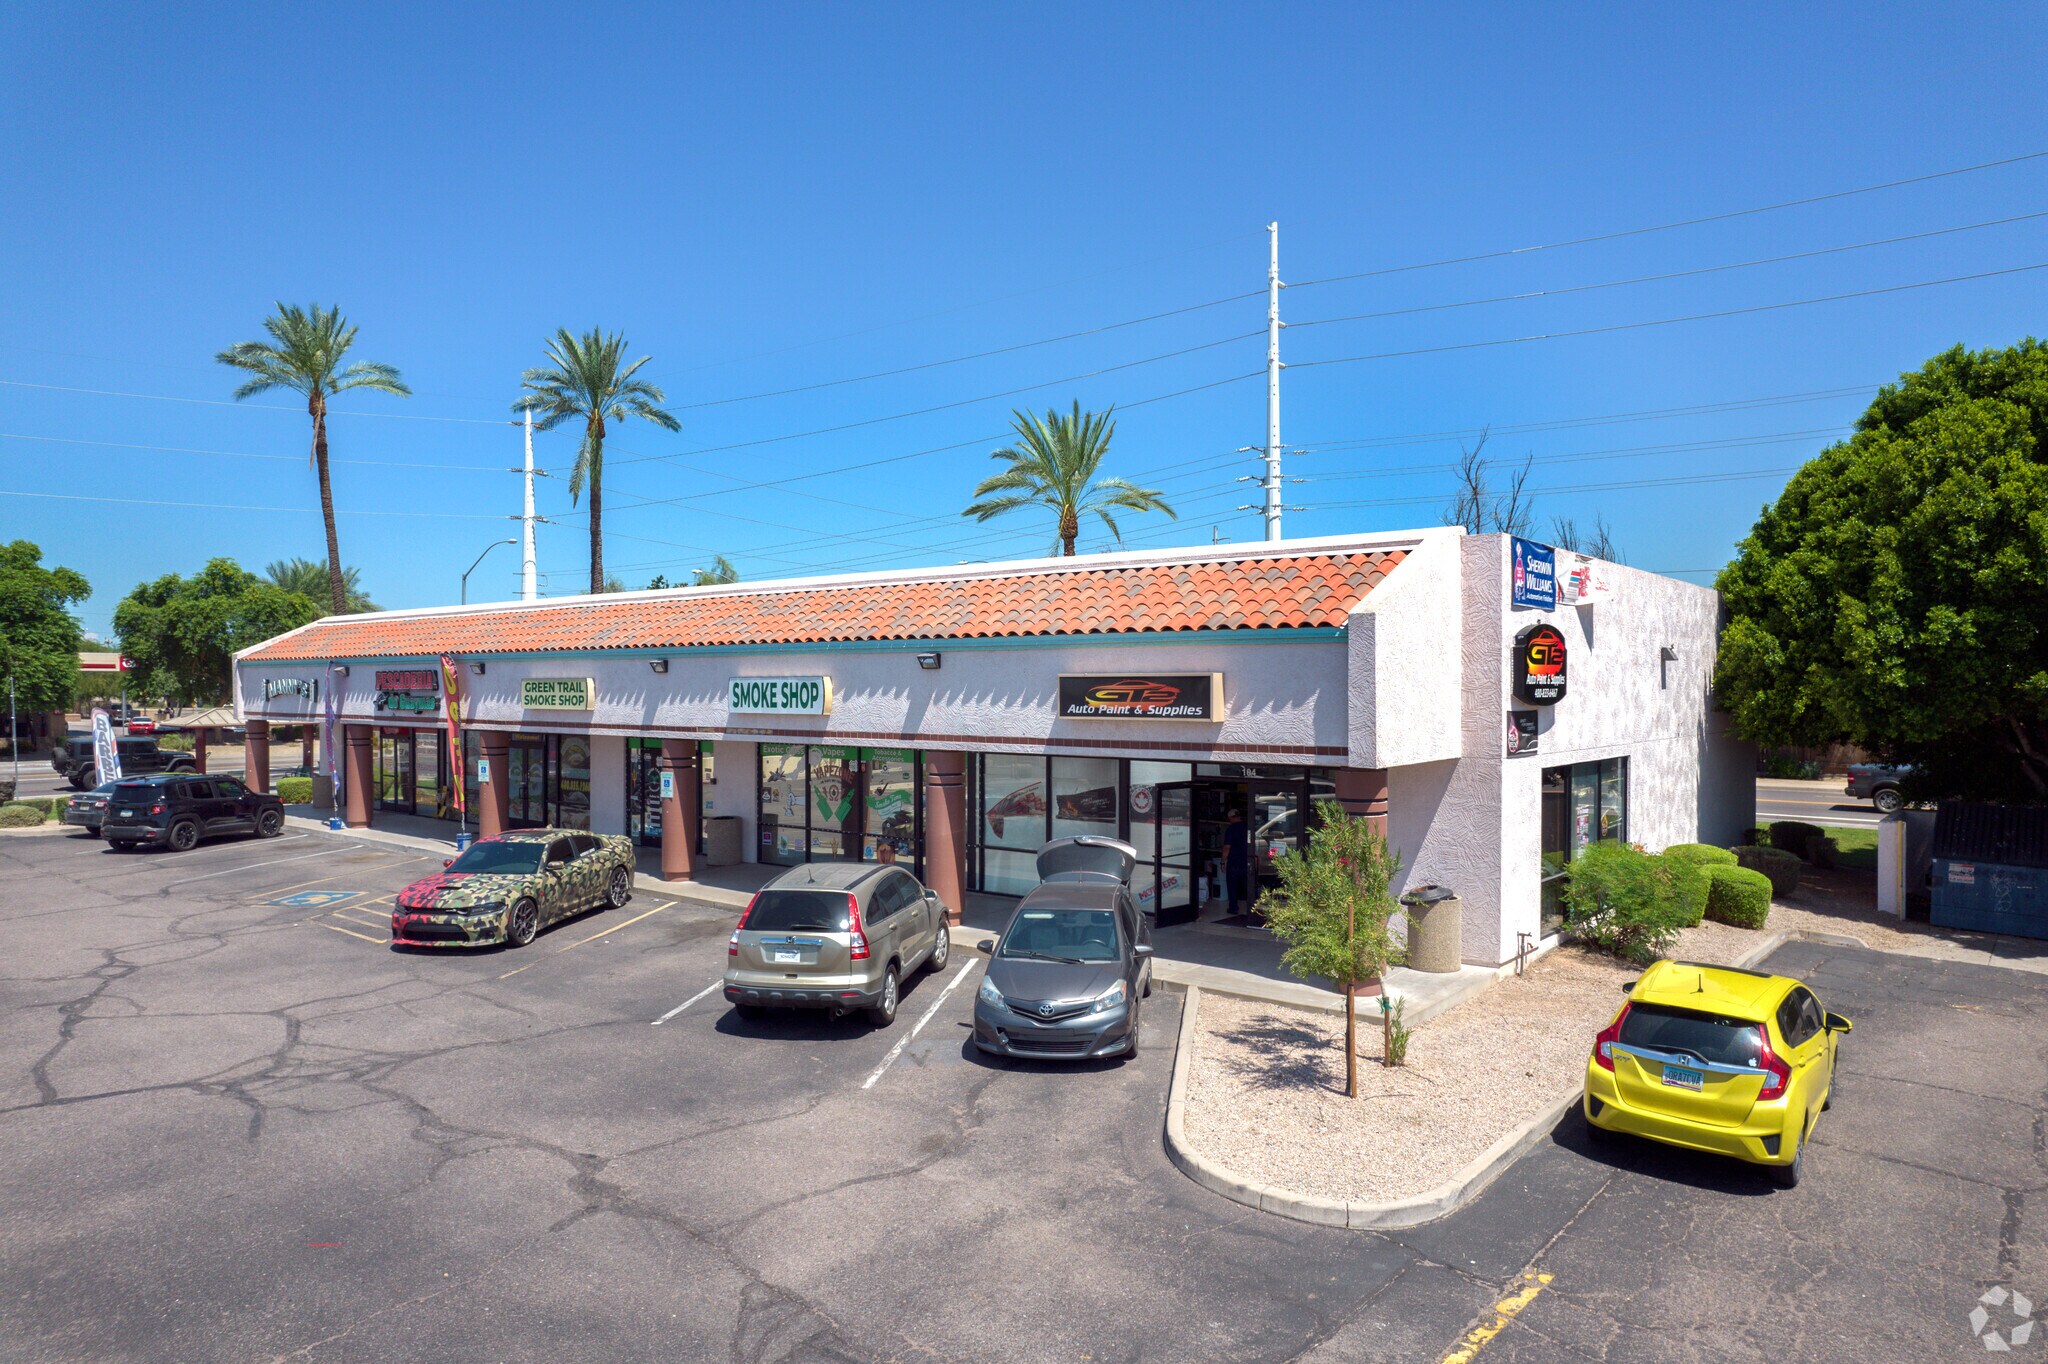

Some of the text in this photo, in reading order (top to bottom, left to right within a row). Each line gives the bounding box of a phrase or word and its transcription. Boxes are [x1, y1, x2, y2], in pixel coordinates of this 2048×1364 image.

[524, 682, 584, 693] GREEN TRAIL
[524, 695, 585, 706] SMOKE SHOP
[732, 682, 819, 709] SMOKE SHOP
[1067, 704, 1203, 716] Auto Paint & Supplies
[823, 748, 845, 757] Vapes
